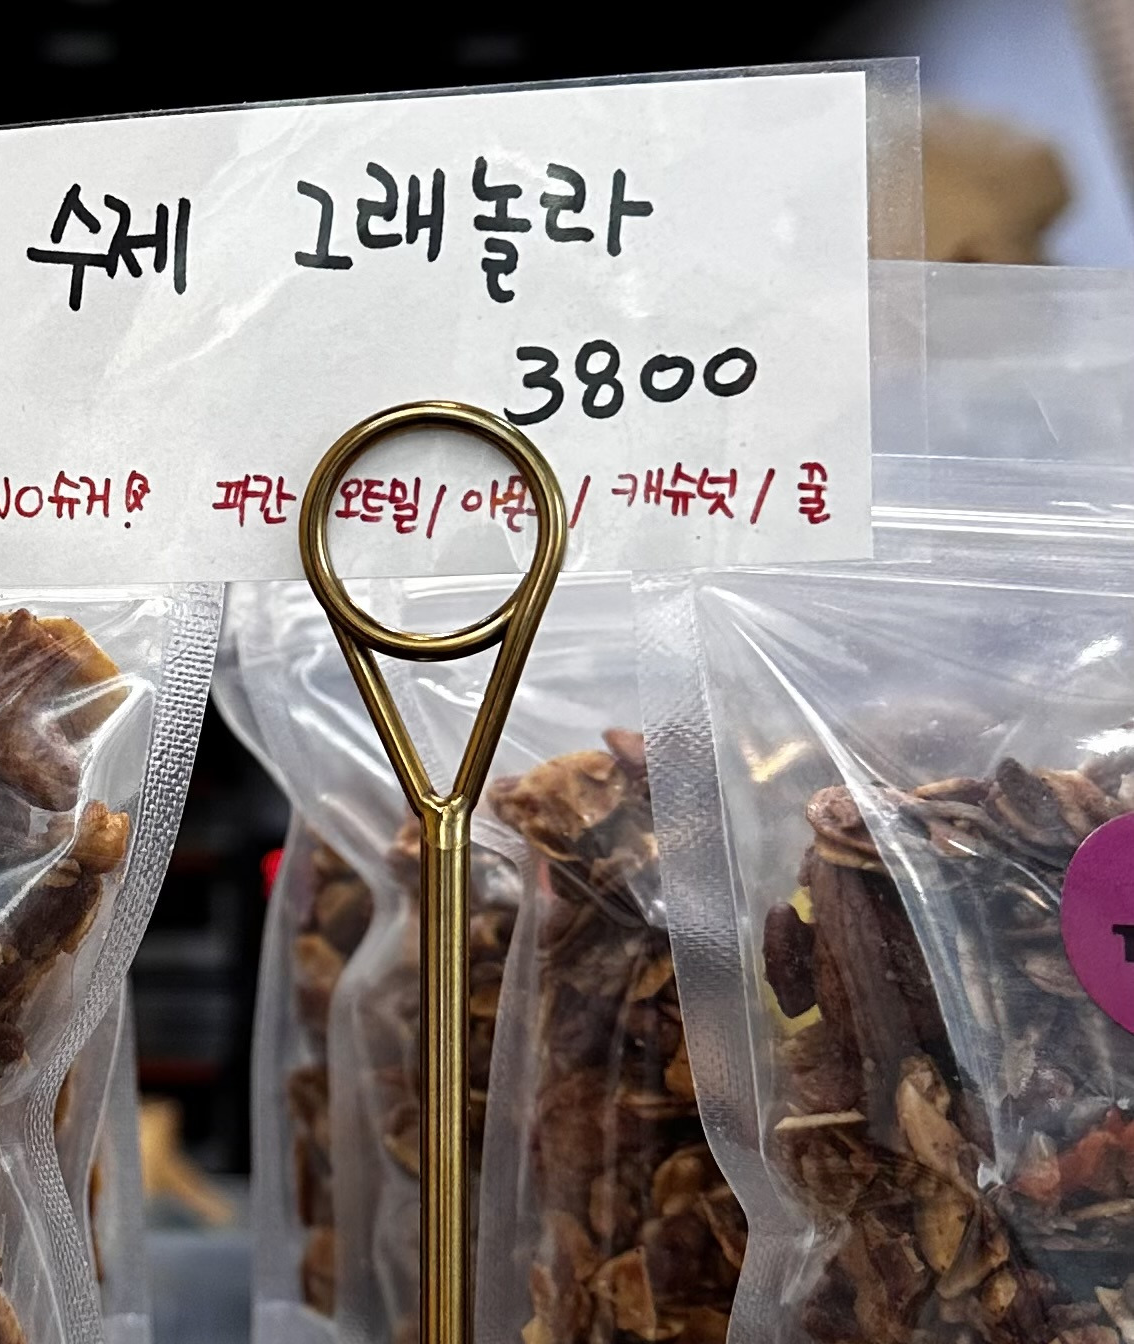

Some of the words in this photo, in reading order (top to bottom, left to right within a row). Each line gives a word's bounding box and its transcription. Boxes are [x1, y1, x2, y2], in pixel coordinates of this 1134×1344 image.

[26, 183, 191, 312] 수제
[294, 156, 654, 304] 그래놀라
[503, 339, 758, 426] 3800
[796, 461, 831, 525] 꿀
